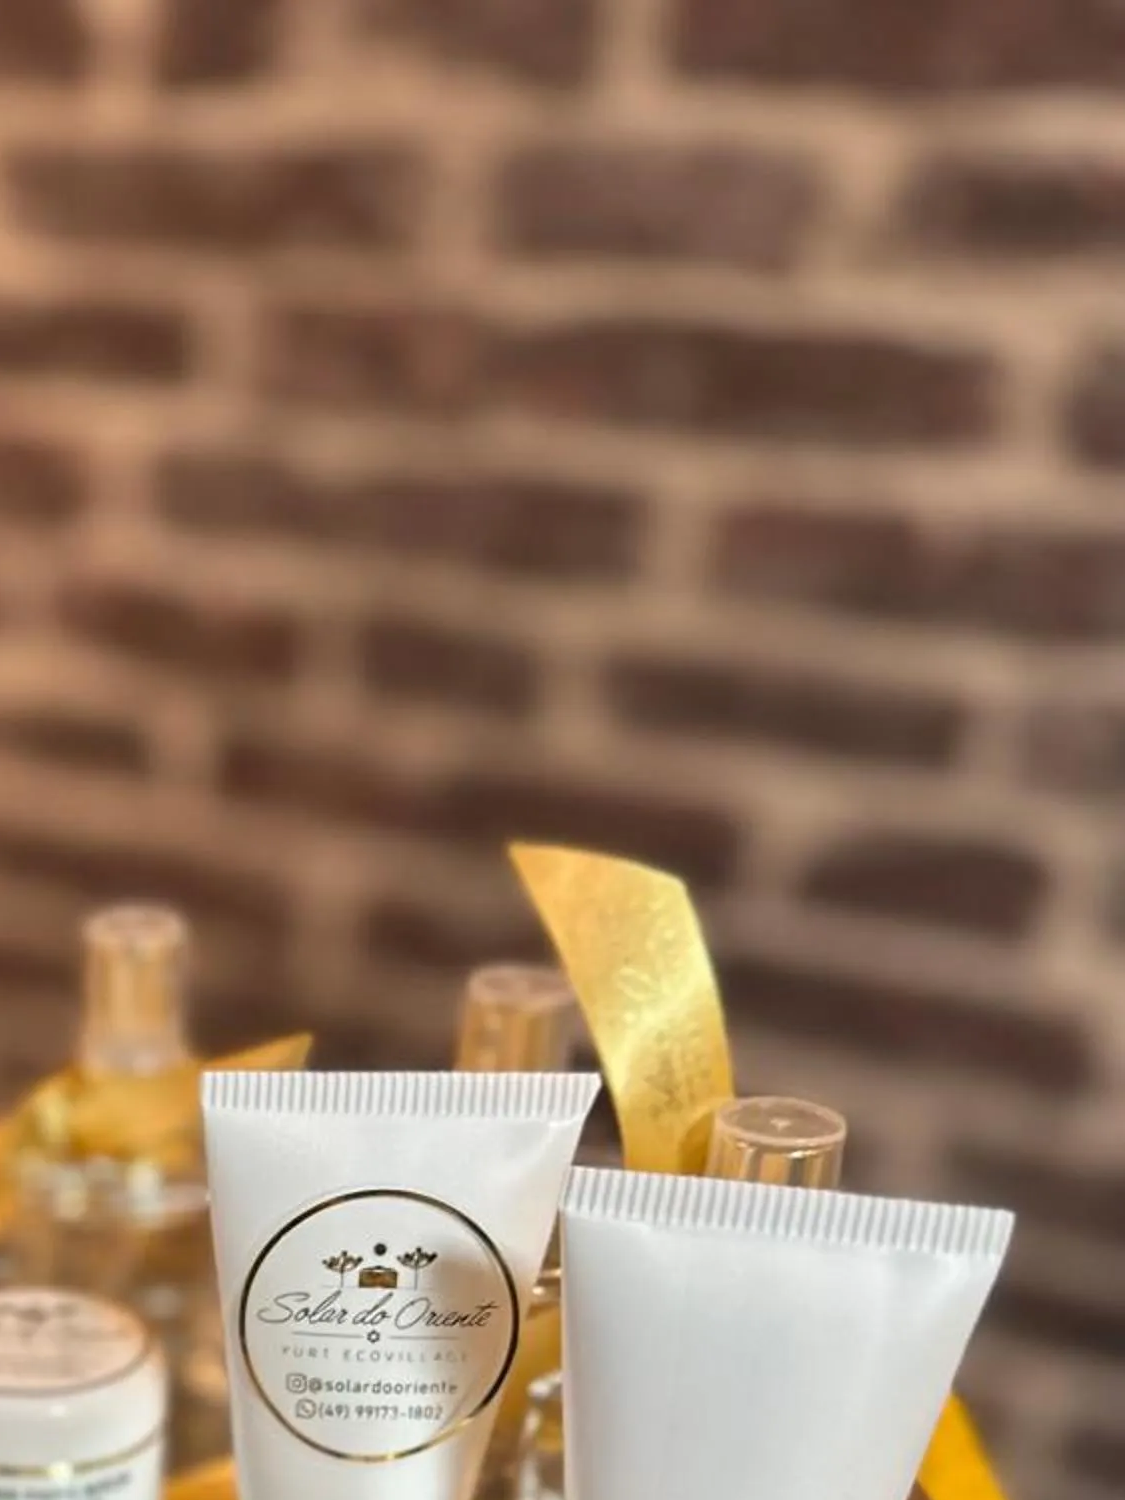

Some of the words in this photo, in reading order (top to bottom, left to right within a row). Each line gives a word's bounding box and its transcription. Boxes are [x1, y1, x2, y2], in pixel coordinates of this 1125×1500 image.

[257, 1290, 349, 1325] Solar
[352, 1292, 393, 1325] do
[394, 1297, 500, 1330] Oriente
[309, 1378, 458, 1394] @solardooriente
[318, 1402, 350, 1419] (49)
[355, 1405, 443, 1420] 99173-1802
